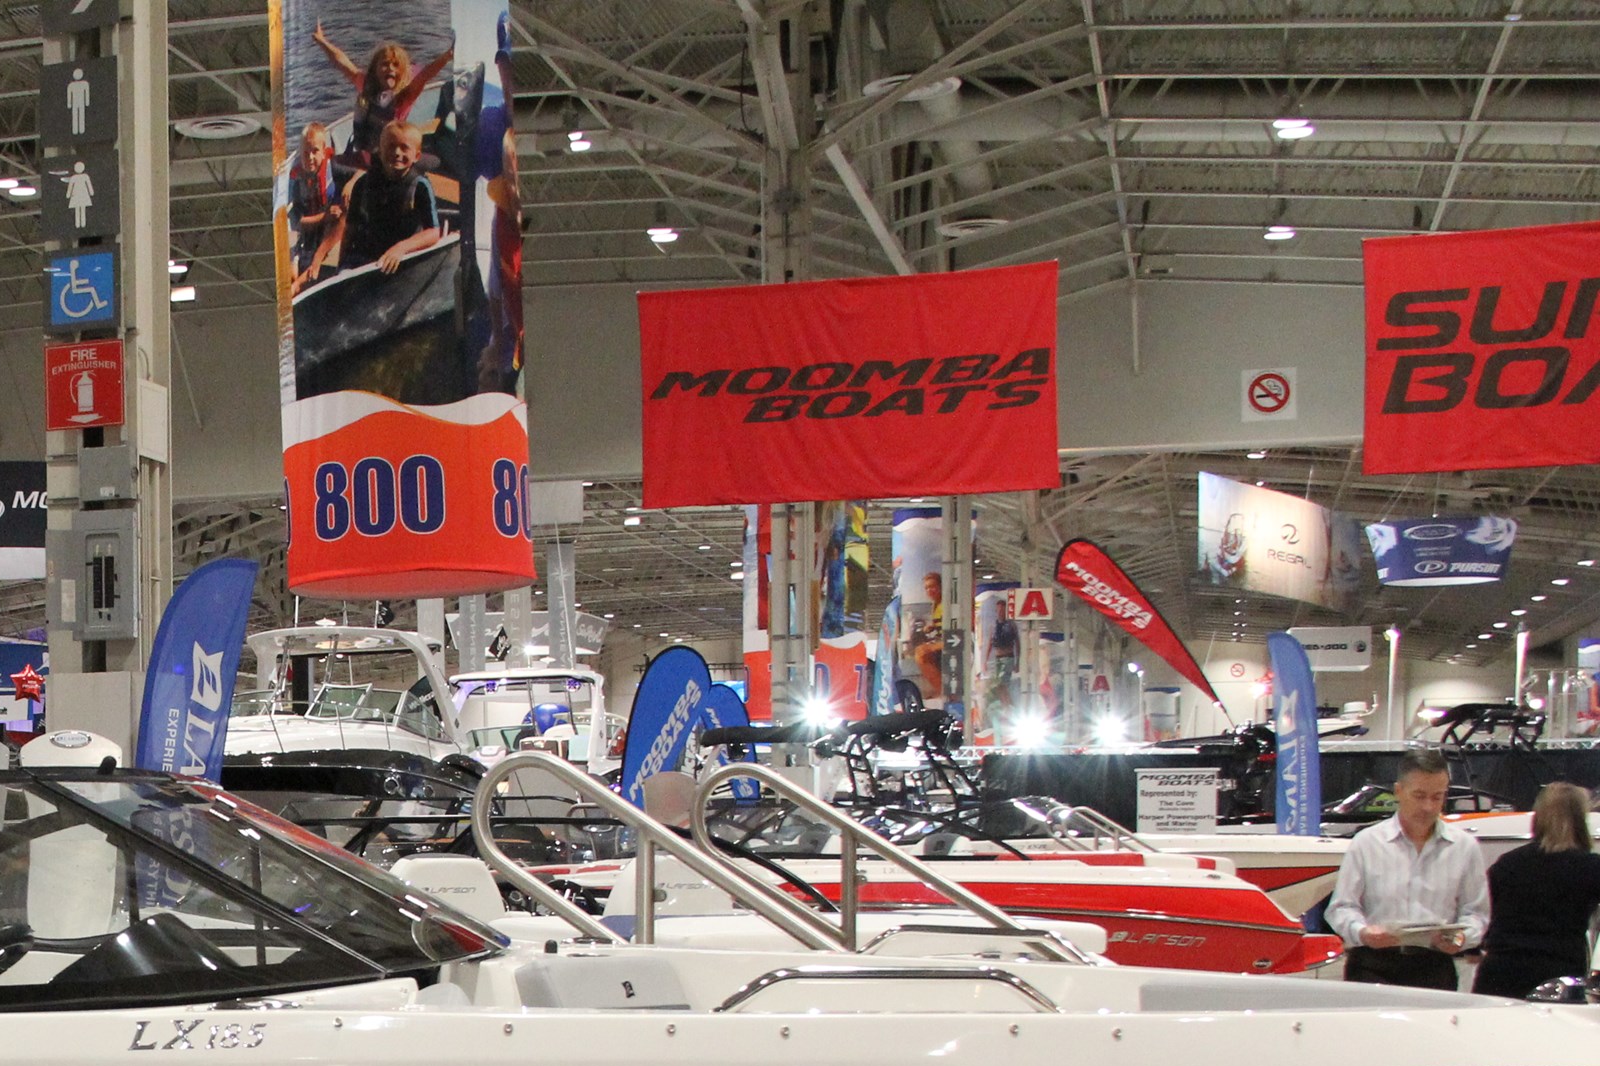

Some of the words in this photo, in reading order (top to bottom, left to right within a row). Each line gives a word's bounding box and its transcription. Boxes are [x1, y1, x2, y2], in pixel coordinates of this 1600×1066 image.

[51, 360, 117, 376] EXTINGUISHER
[70, 348, 98, 362] FIRE
[650, 347, 1051, 401] MOOMBA
[743, 378, 1049, 424] BOATS
[314, 454, 446, 542] 800
[1268, 549, 1312, 570] REGAL
[1449, 562, 1501, 574] PURSUIT
[1019, 590, 1050, 618] A
[1065, 561, 1153, 624] MOOMBA
[1081, 584, 1148, 630] BOATS
[161, 708, 180, 773] EXPERIE
[629, 679, 700, 802] MOOMBA
[651, 690, 702, 775] BOATS
